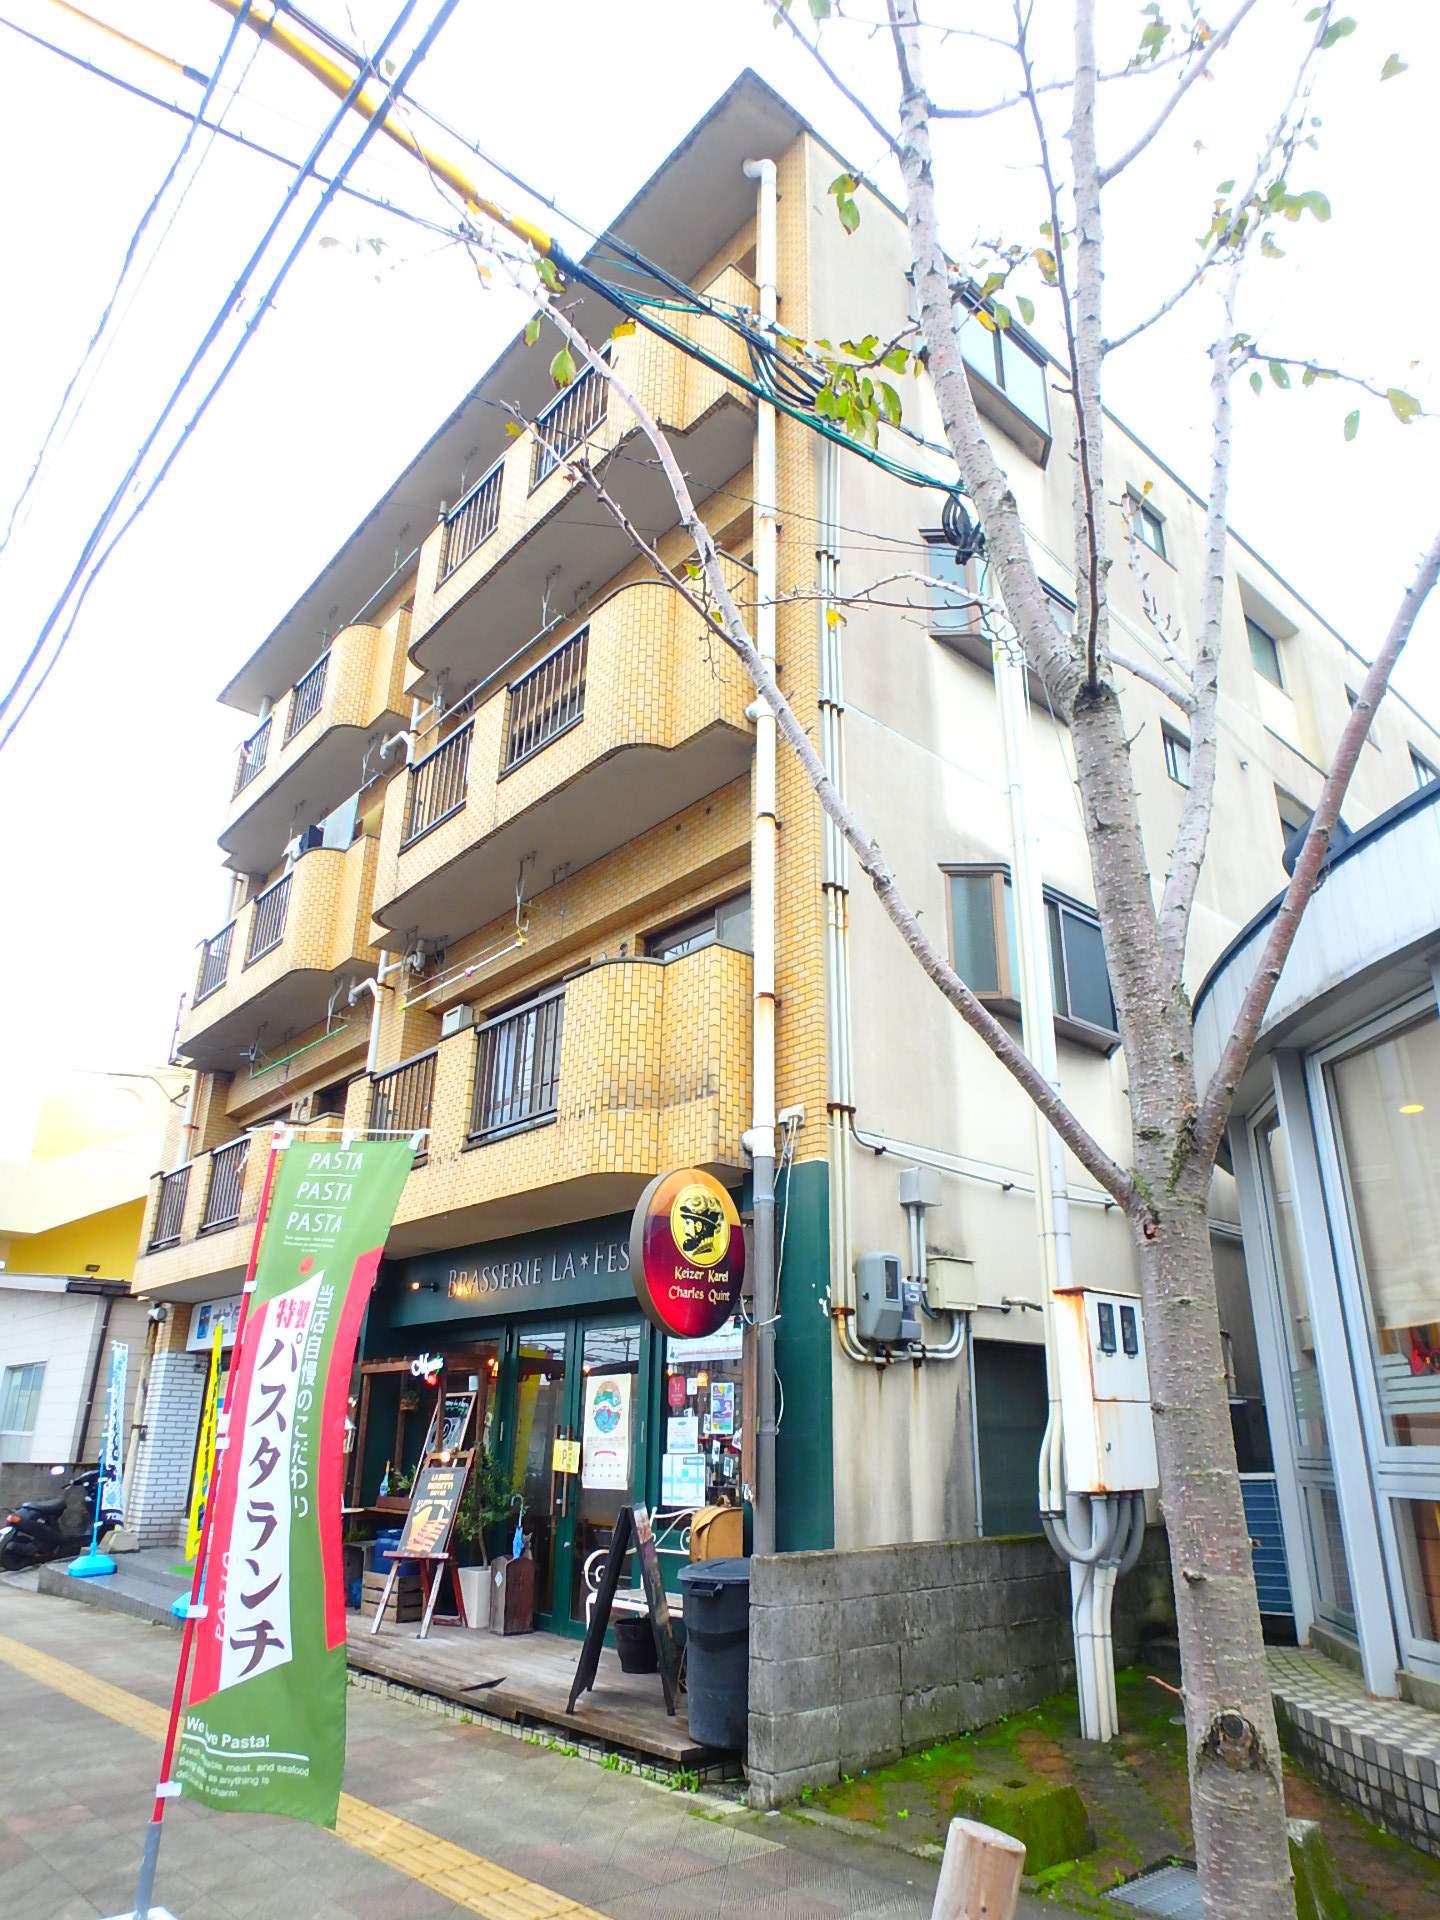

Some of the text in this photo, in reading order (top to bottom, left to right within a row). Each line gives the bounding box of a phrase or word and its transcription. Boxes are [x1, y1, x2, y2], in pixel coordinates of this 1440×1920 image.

[308, 1151, 364, 1170] PASTA
[296, 1181, 353, 1202] PASTA
[286, 1212, 343, 1233] PASTA
[448, 1257, 544, 1298] BRASSERIE
[551, 1250, 577, 1282] LA
[674, 1265, 729, 1283] Keizer Karel
[668, 1285, 730, 1305] Charles Quint
[276, 1298, 311, 1329] 特製
[229, 1332, 303, 1678] パスタランチ
[186, 1715, 205, 1733] We
[221, 1733, 270, 1749] Pasta!
